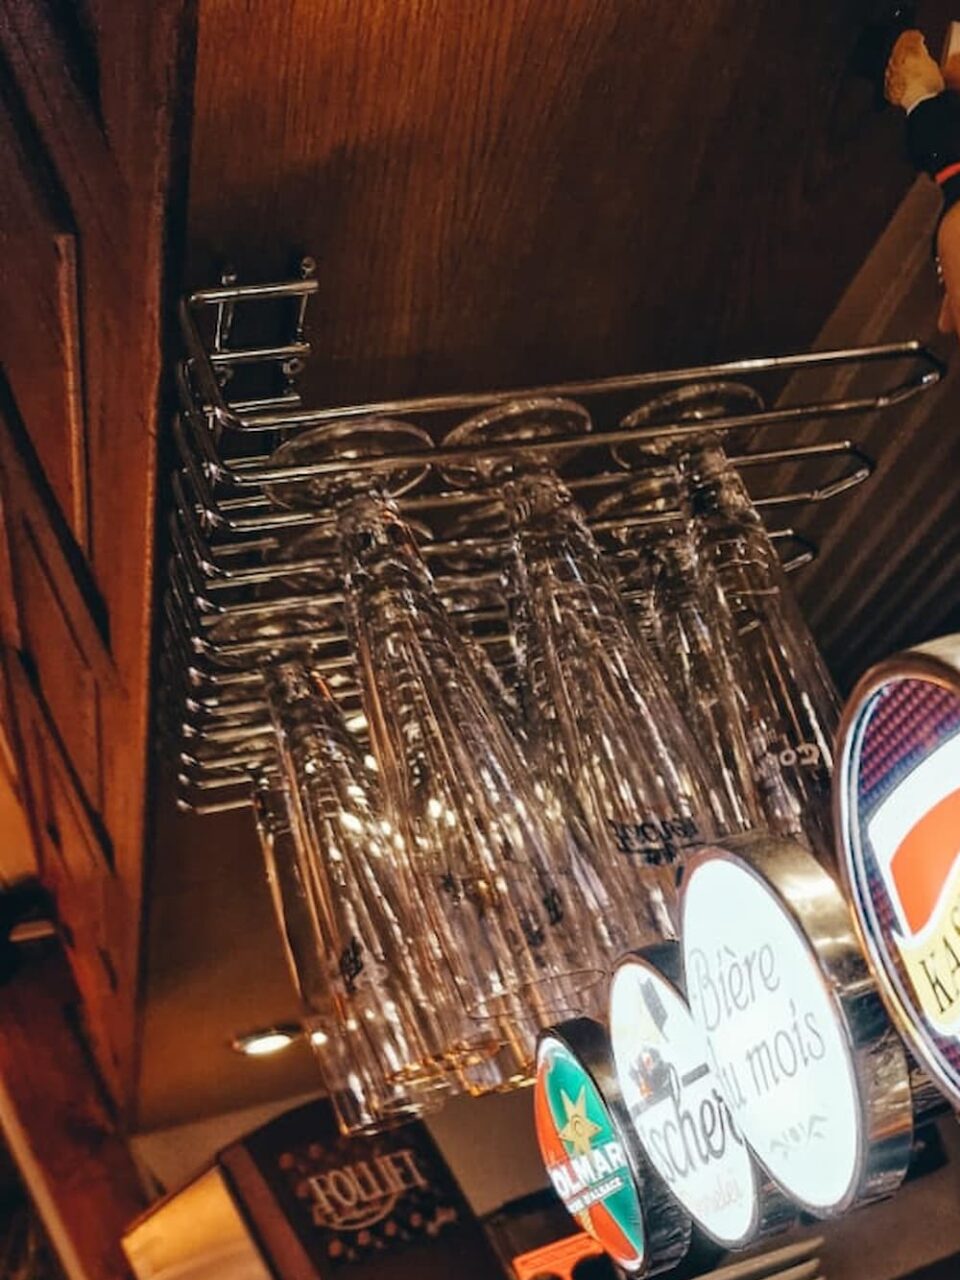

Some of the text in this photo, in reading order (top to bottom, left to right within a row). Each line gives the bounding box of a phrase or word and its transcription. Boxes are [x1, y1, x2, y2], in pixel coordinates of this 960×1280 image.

[690, 944, 780, 1031] Bière
[745, 998, 825, 1096] mois
[547, 1142, 627, 1201] OLMAR
